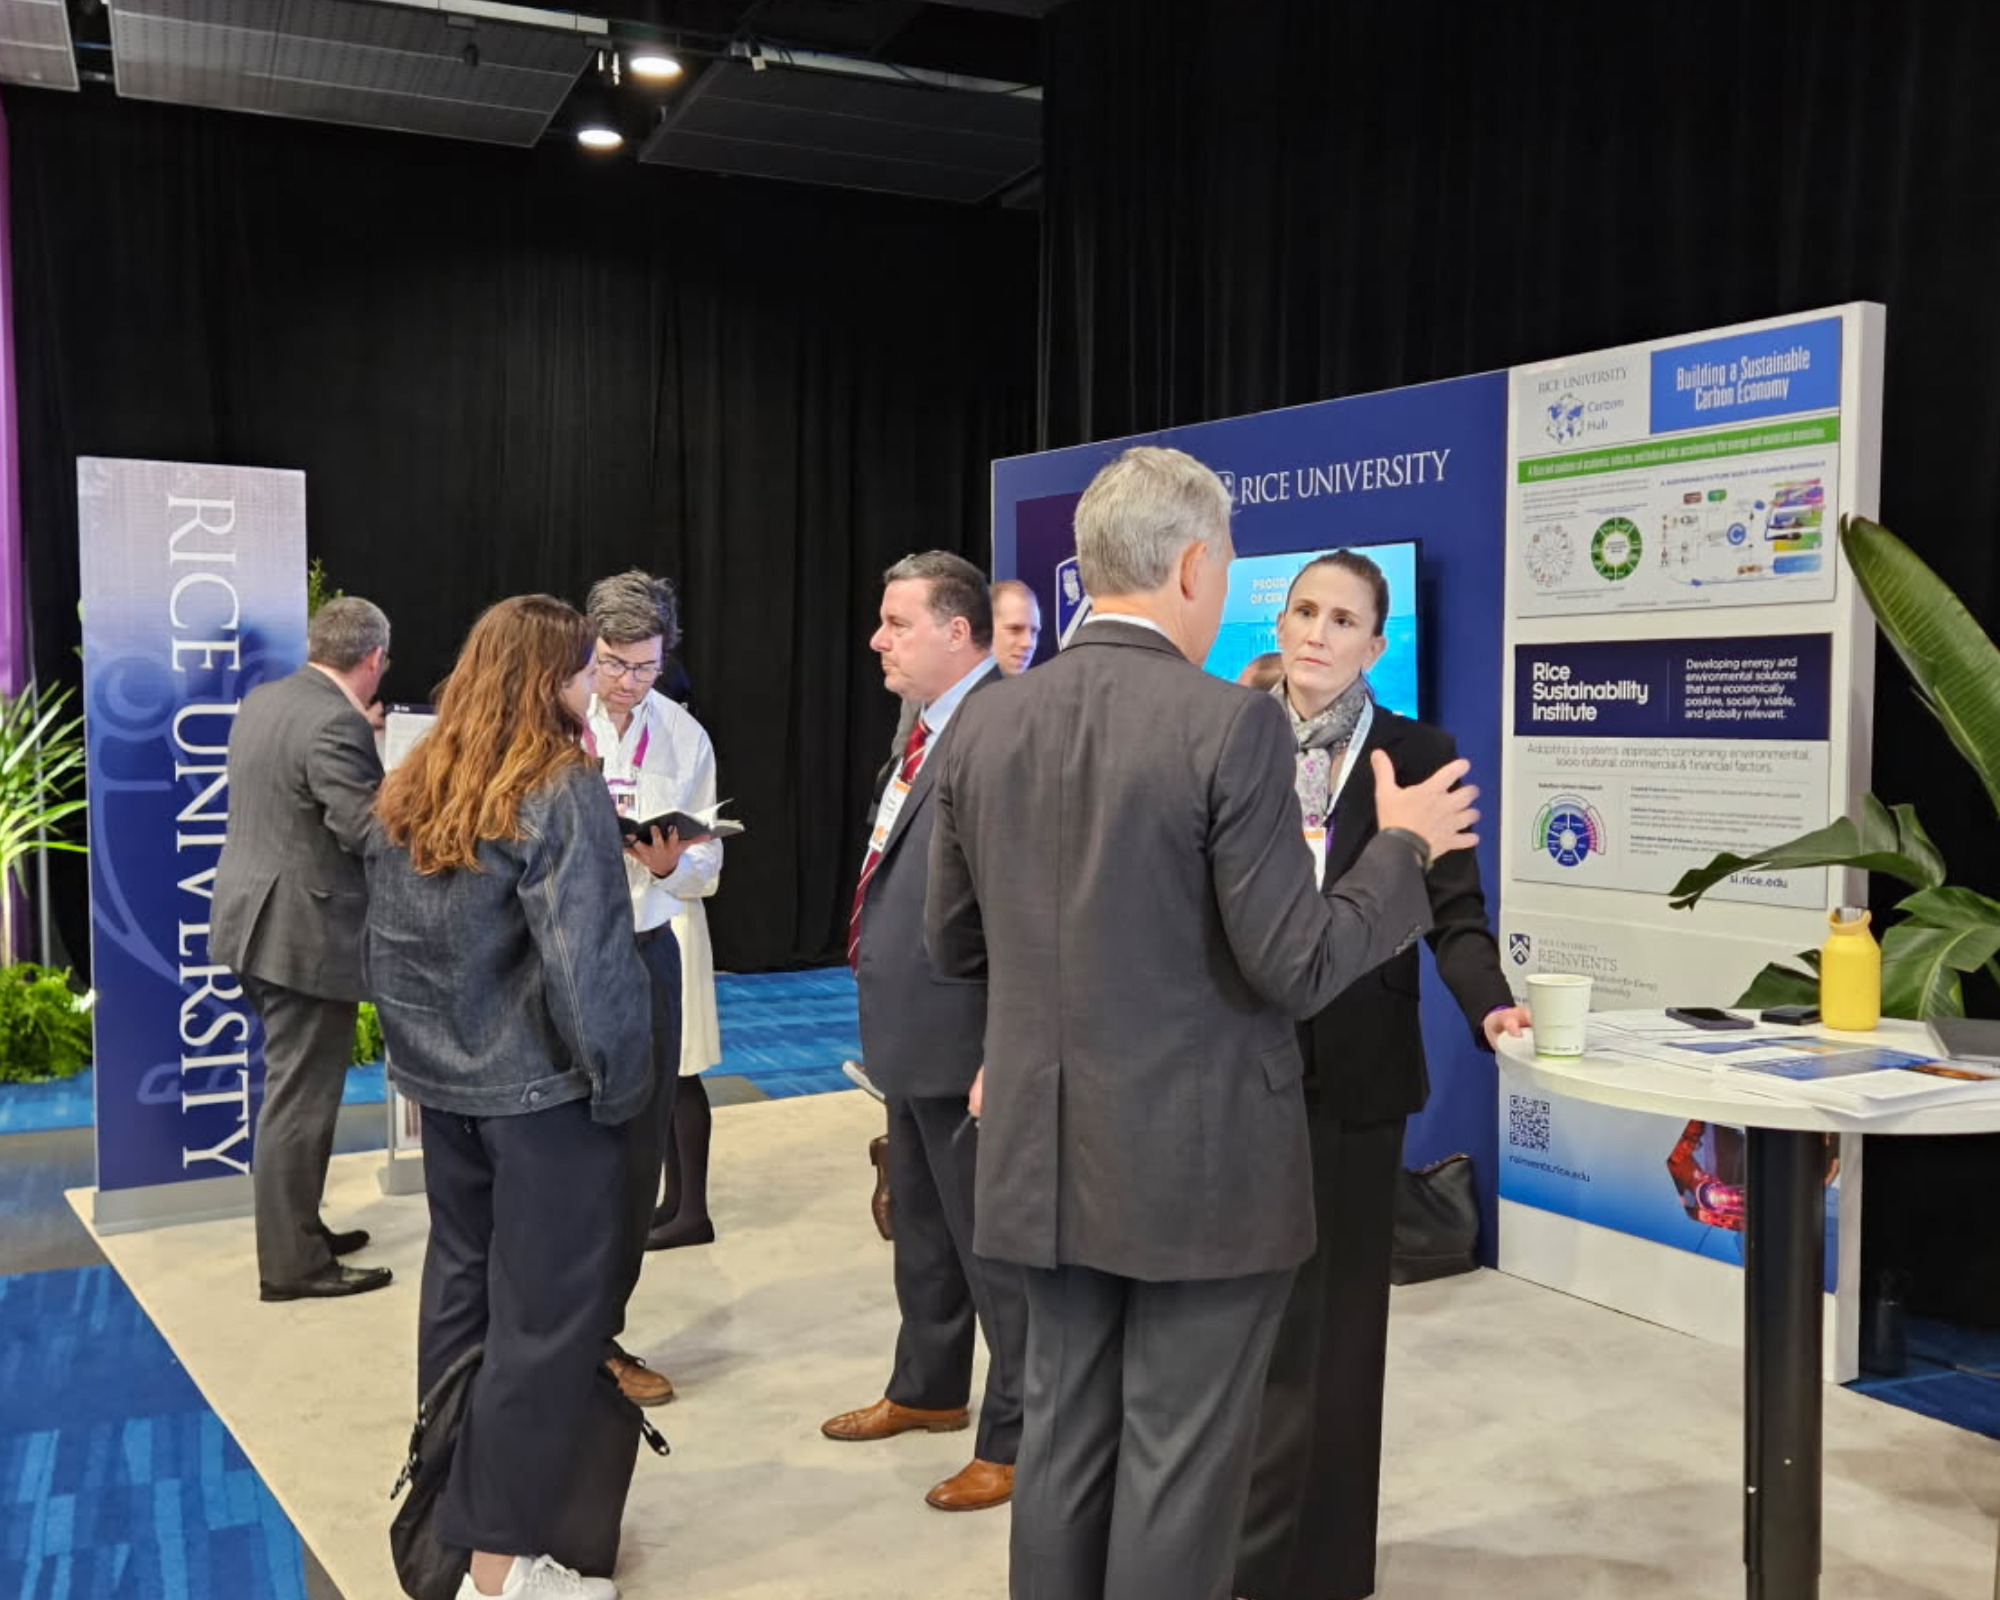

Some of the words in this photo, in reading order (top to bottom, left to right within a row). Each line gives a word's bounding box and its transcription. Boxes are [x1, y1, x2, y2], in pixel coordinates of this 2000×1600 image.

[1676, 361, 1726, 391] Building
[1730, 363, 1737, 382] a
[1740, 345, 1811, 380] Sustainable
[1564, 367, 1627, 389] UNIVERSITY
[1695, 385, 1735, 411] Carbon
[1737, 378, 1790, 404] Economy
[1587, 399, 1624, 413] Carbon
[1587, 418, 1608, 430] Hub
[1241, 471, 1290, 505] RICE
[1297, 449, 1451, 498] UNIVERSITY
[168, 496, 241, 673] RICE
[1533, 662, 1571, 681] Rice
[1686, 658, 1740, 671] Developing
[1741, 659, 1775, 671] energy
[1777, 656, 1798, 668] and
[1685, 671, 1753, 682] environmental
[1755, 669, 1797, 680] solutions
[1532, 680, 1649, 705] Sustainability
[1685, 683, 1704, 694] that
[1705, 685, 1721, 694] are
[1722, 682, 1785, 697] economically
[1685, 696, 1724, 707] positive,
[1726, 695, 1760, 709] socially
[1764, 695, 1796, 707] viable,
[1532, 702, 1598, 721] Institute
[1685, 708, 1703, 718] and
[1704, 708, 1742, 720] globally
[1744, 709, 1787, 719] relevant.
[1621, 745, 1669, 758] approach
[1689, 760, 1733, 771] financial
[1729, 872, 1789, 888] si.rice.edu
[1538, 948, 1618, 972] REINVENTS
